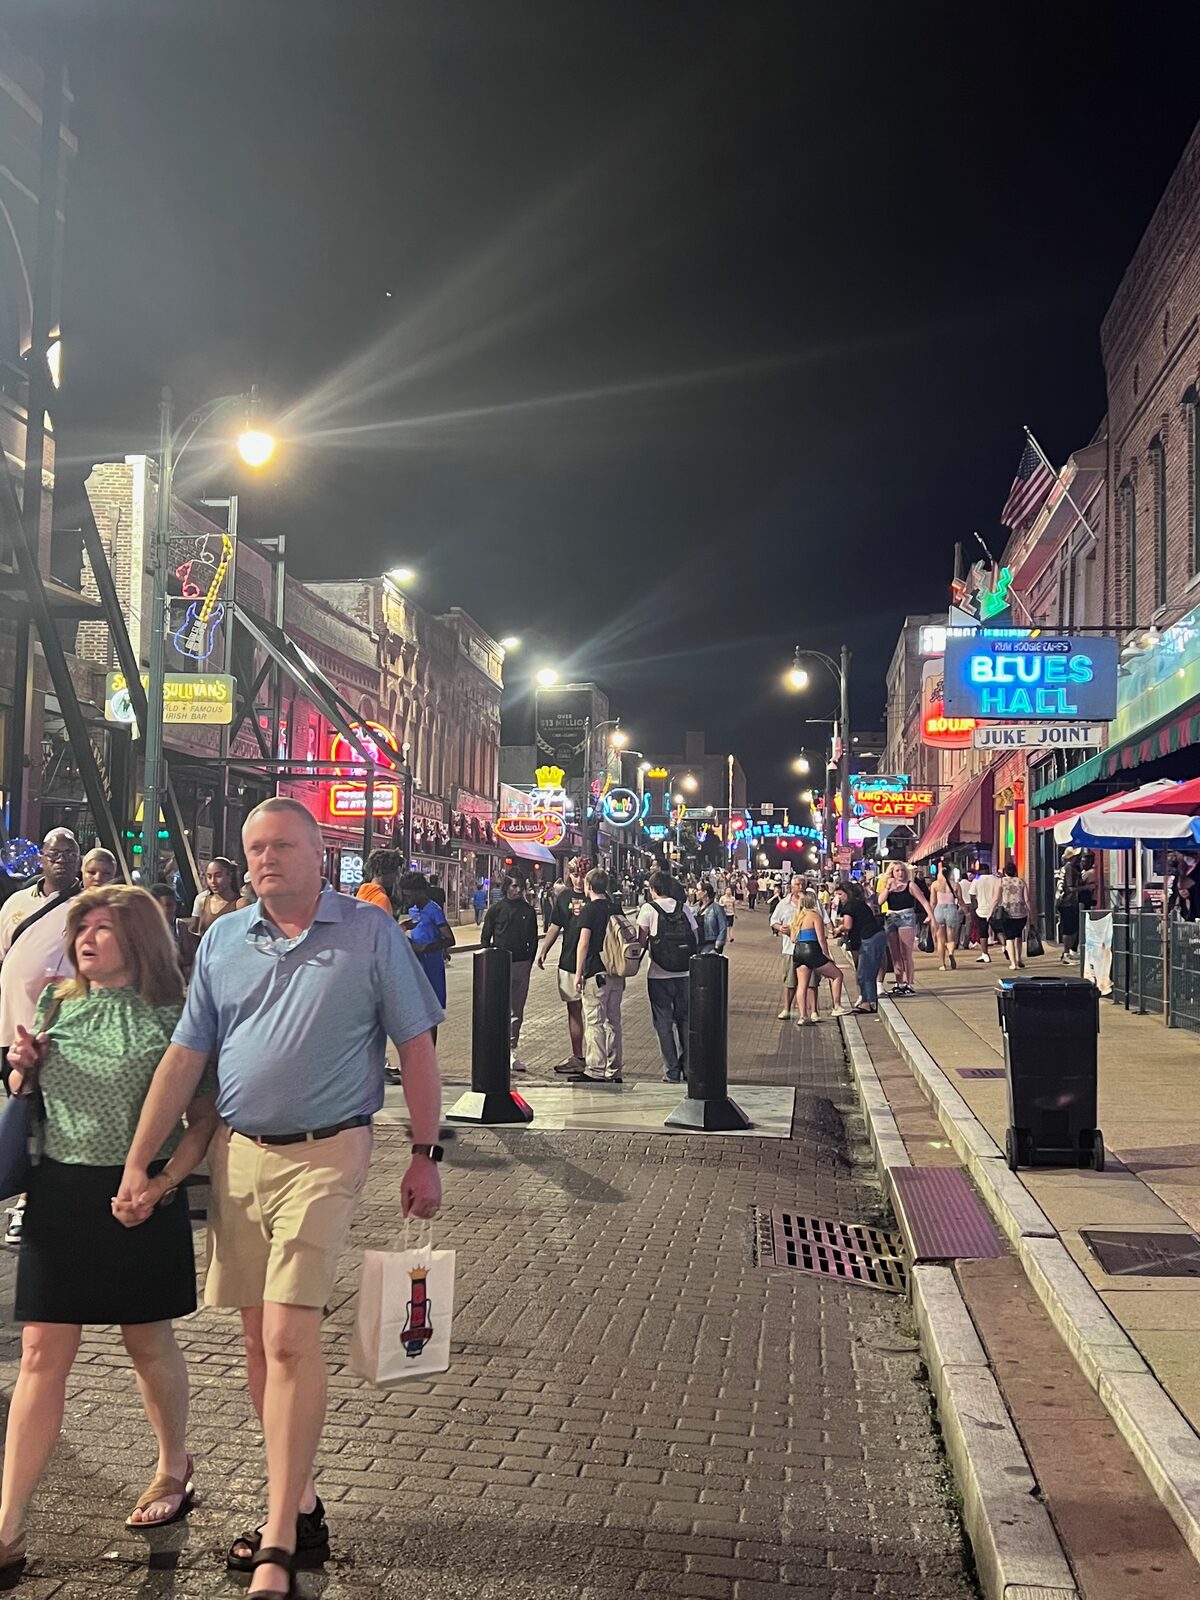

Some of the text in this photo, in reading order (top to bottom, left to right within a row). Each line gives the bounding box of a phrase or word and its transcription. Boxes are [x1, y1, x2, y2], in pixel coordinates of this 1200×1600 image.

[970, 654, 1093, 683] BLUES
[981, 687, 1078, 714] HALL
[165, 712, 207, 720] IRISH BAR
[190, 705, 224, 713] FAMOUS
[981, 727, 1092, 746] JUKE JOINT
[873, 803, 915, 814] CAFE
